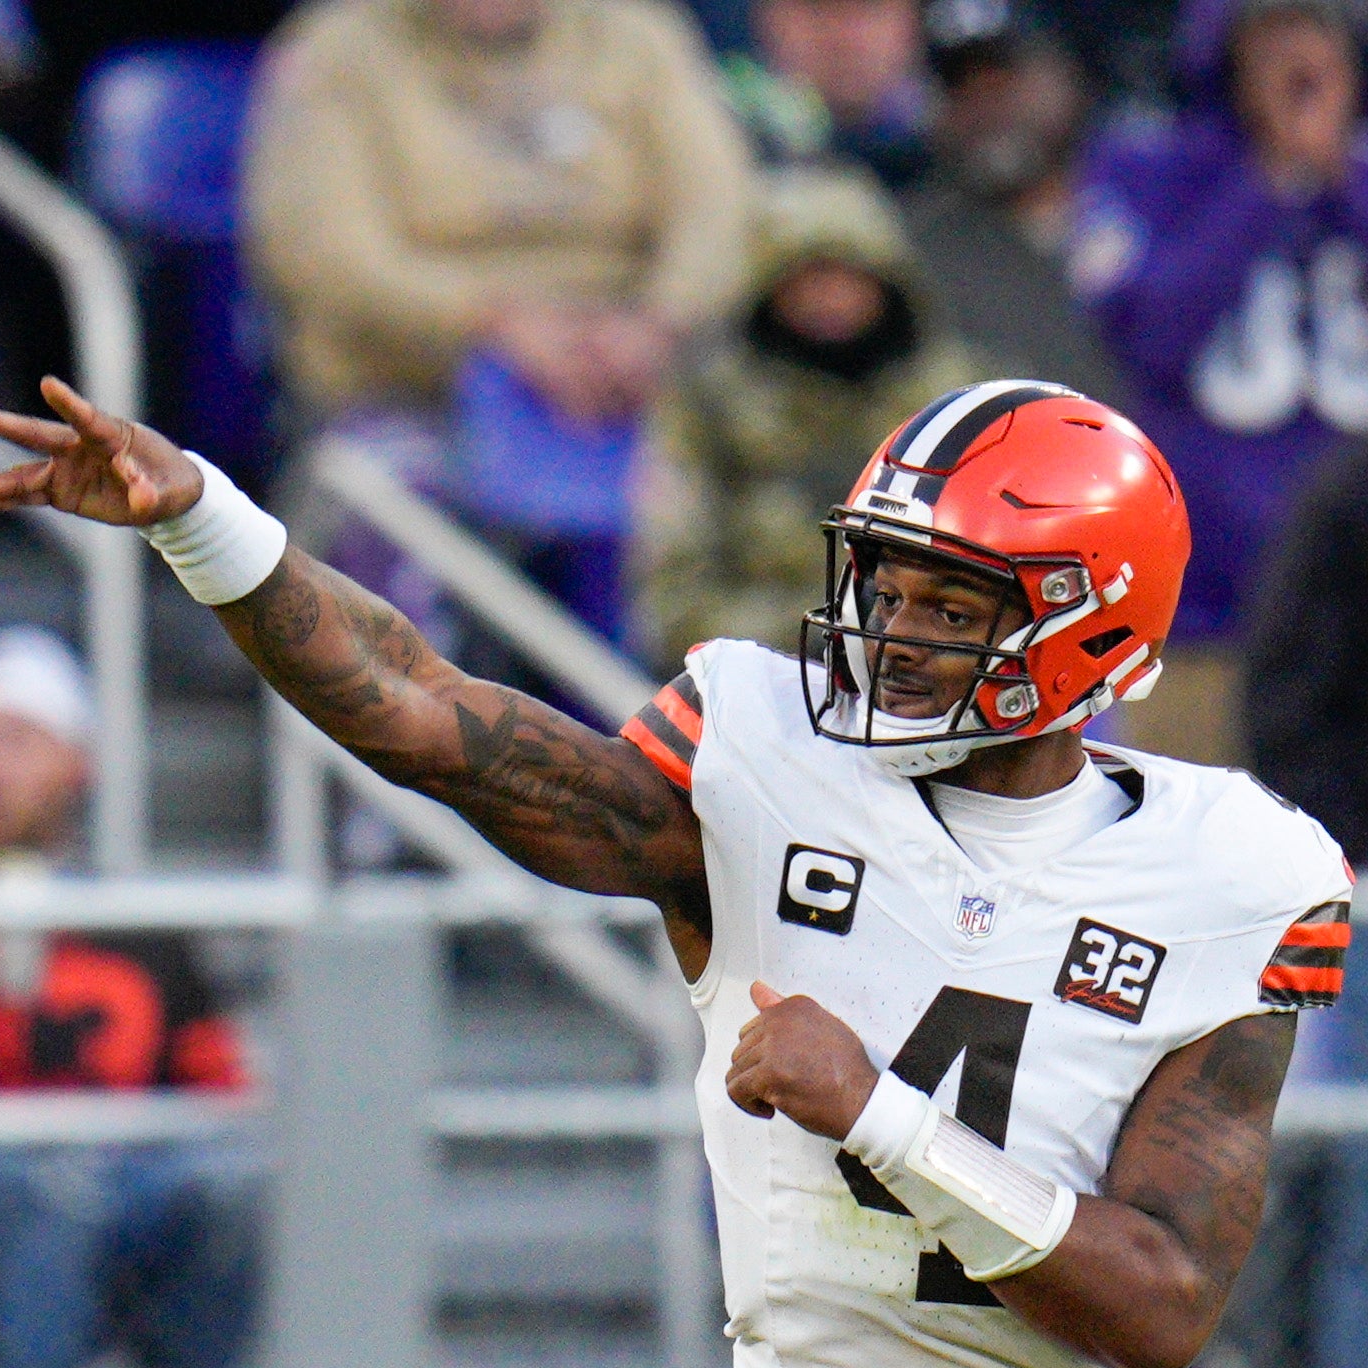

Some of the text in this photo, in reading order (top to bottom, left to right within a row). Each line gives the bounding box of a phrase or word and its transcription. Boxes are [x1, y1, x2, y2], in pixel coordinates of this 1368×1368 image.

[786, 850, 856, 911] C
[960, 909, 988, 931] NFL
[1069, 927, 1156, 1006] 32
[835, 985, 1033, 1307] 4
